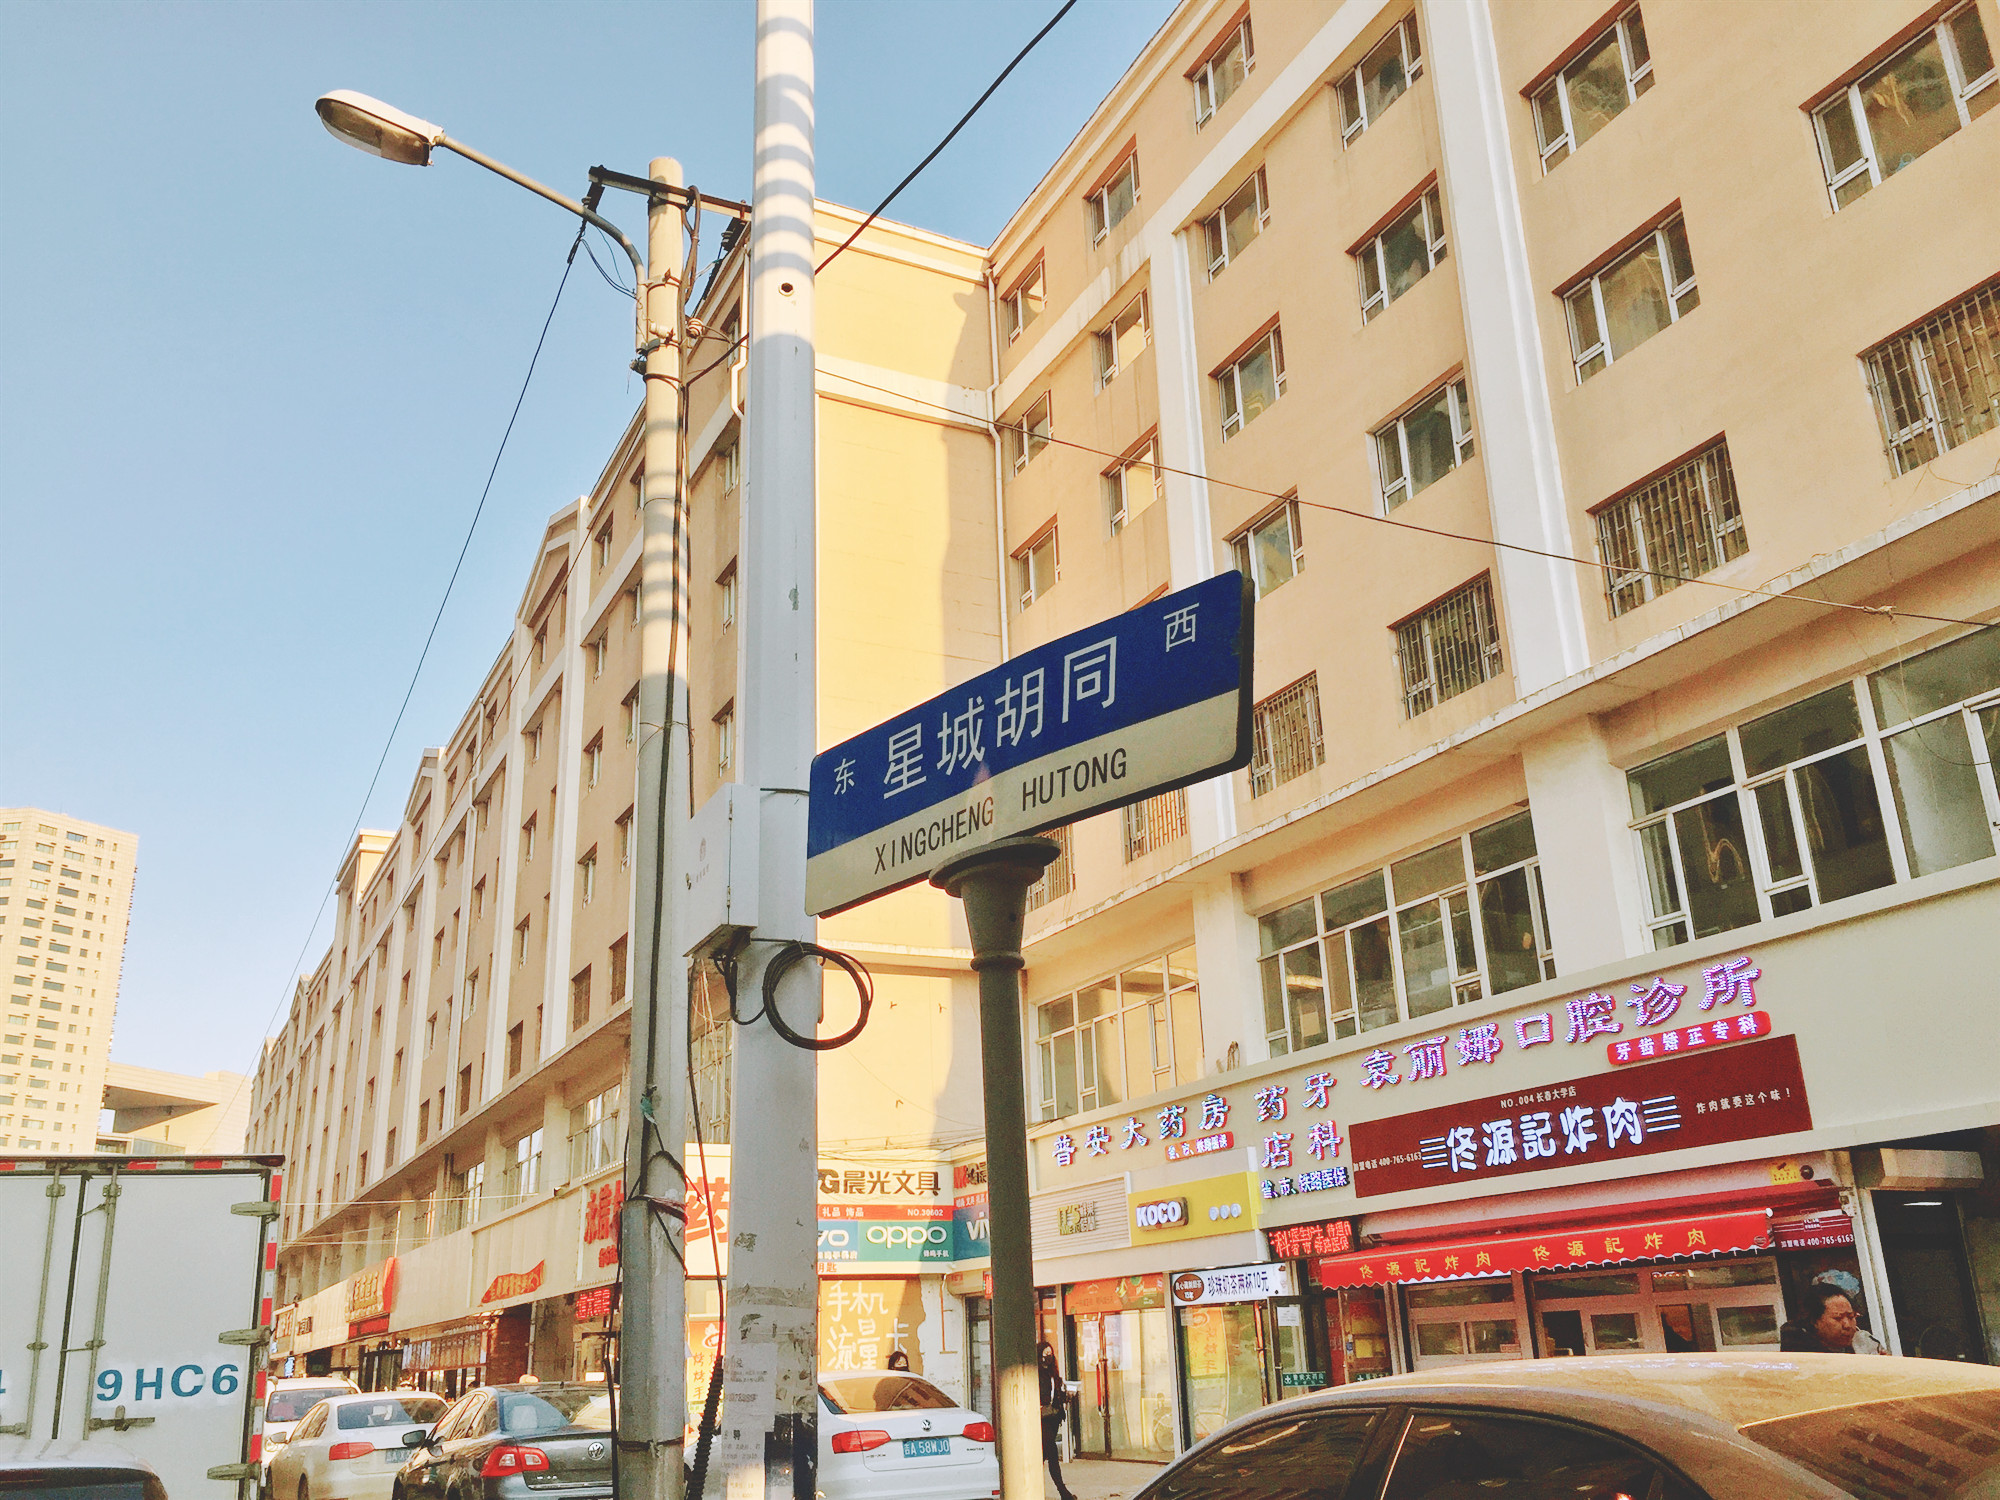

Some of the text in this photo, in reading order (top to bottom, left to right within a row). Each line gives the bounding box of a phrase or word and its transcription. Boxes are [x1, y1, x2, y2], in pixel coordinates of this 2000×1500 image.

[833, 601, 1200, 801] 东 星城胡同 西
[874, 747, 1128, 876] XINGCHENG HUTONG
[1360, 956, 1762, 1091] 袁丽娜口腔诊所
[1615, 1013, 1758, 1061] 牙齿矫正专科
[1051, 1093, 1232, 1167] 普安大药房
[1446, 1095, 1647, 1173] 佟源記炸肉
[1378, 1151, 1422, 1167] 400-765-6163
[843, 1169, 942, 1197] 晨光文具
[822, 1206, 841, 1218] 礼品
[1135, 1200, 1183, 1228] KOCO
[866, 1225, 947, 1250] oppo
[1359, 1228, 1707, 1280] 佟源記炸肉 佟源記炸肉
[1807, 1233, 1854, 1246] 400-765-6163
[826, 1280, 889, 1323] 手机
